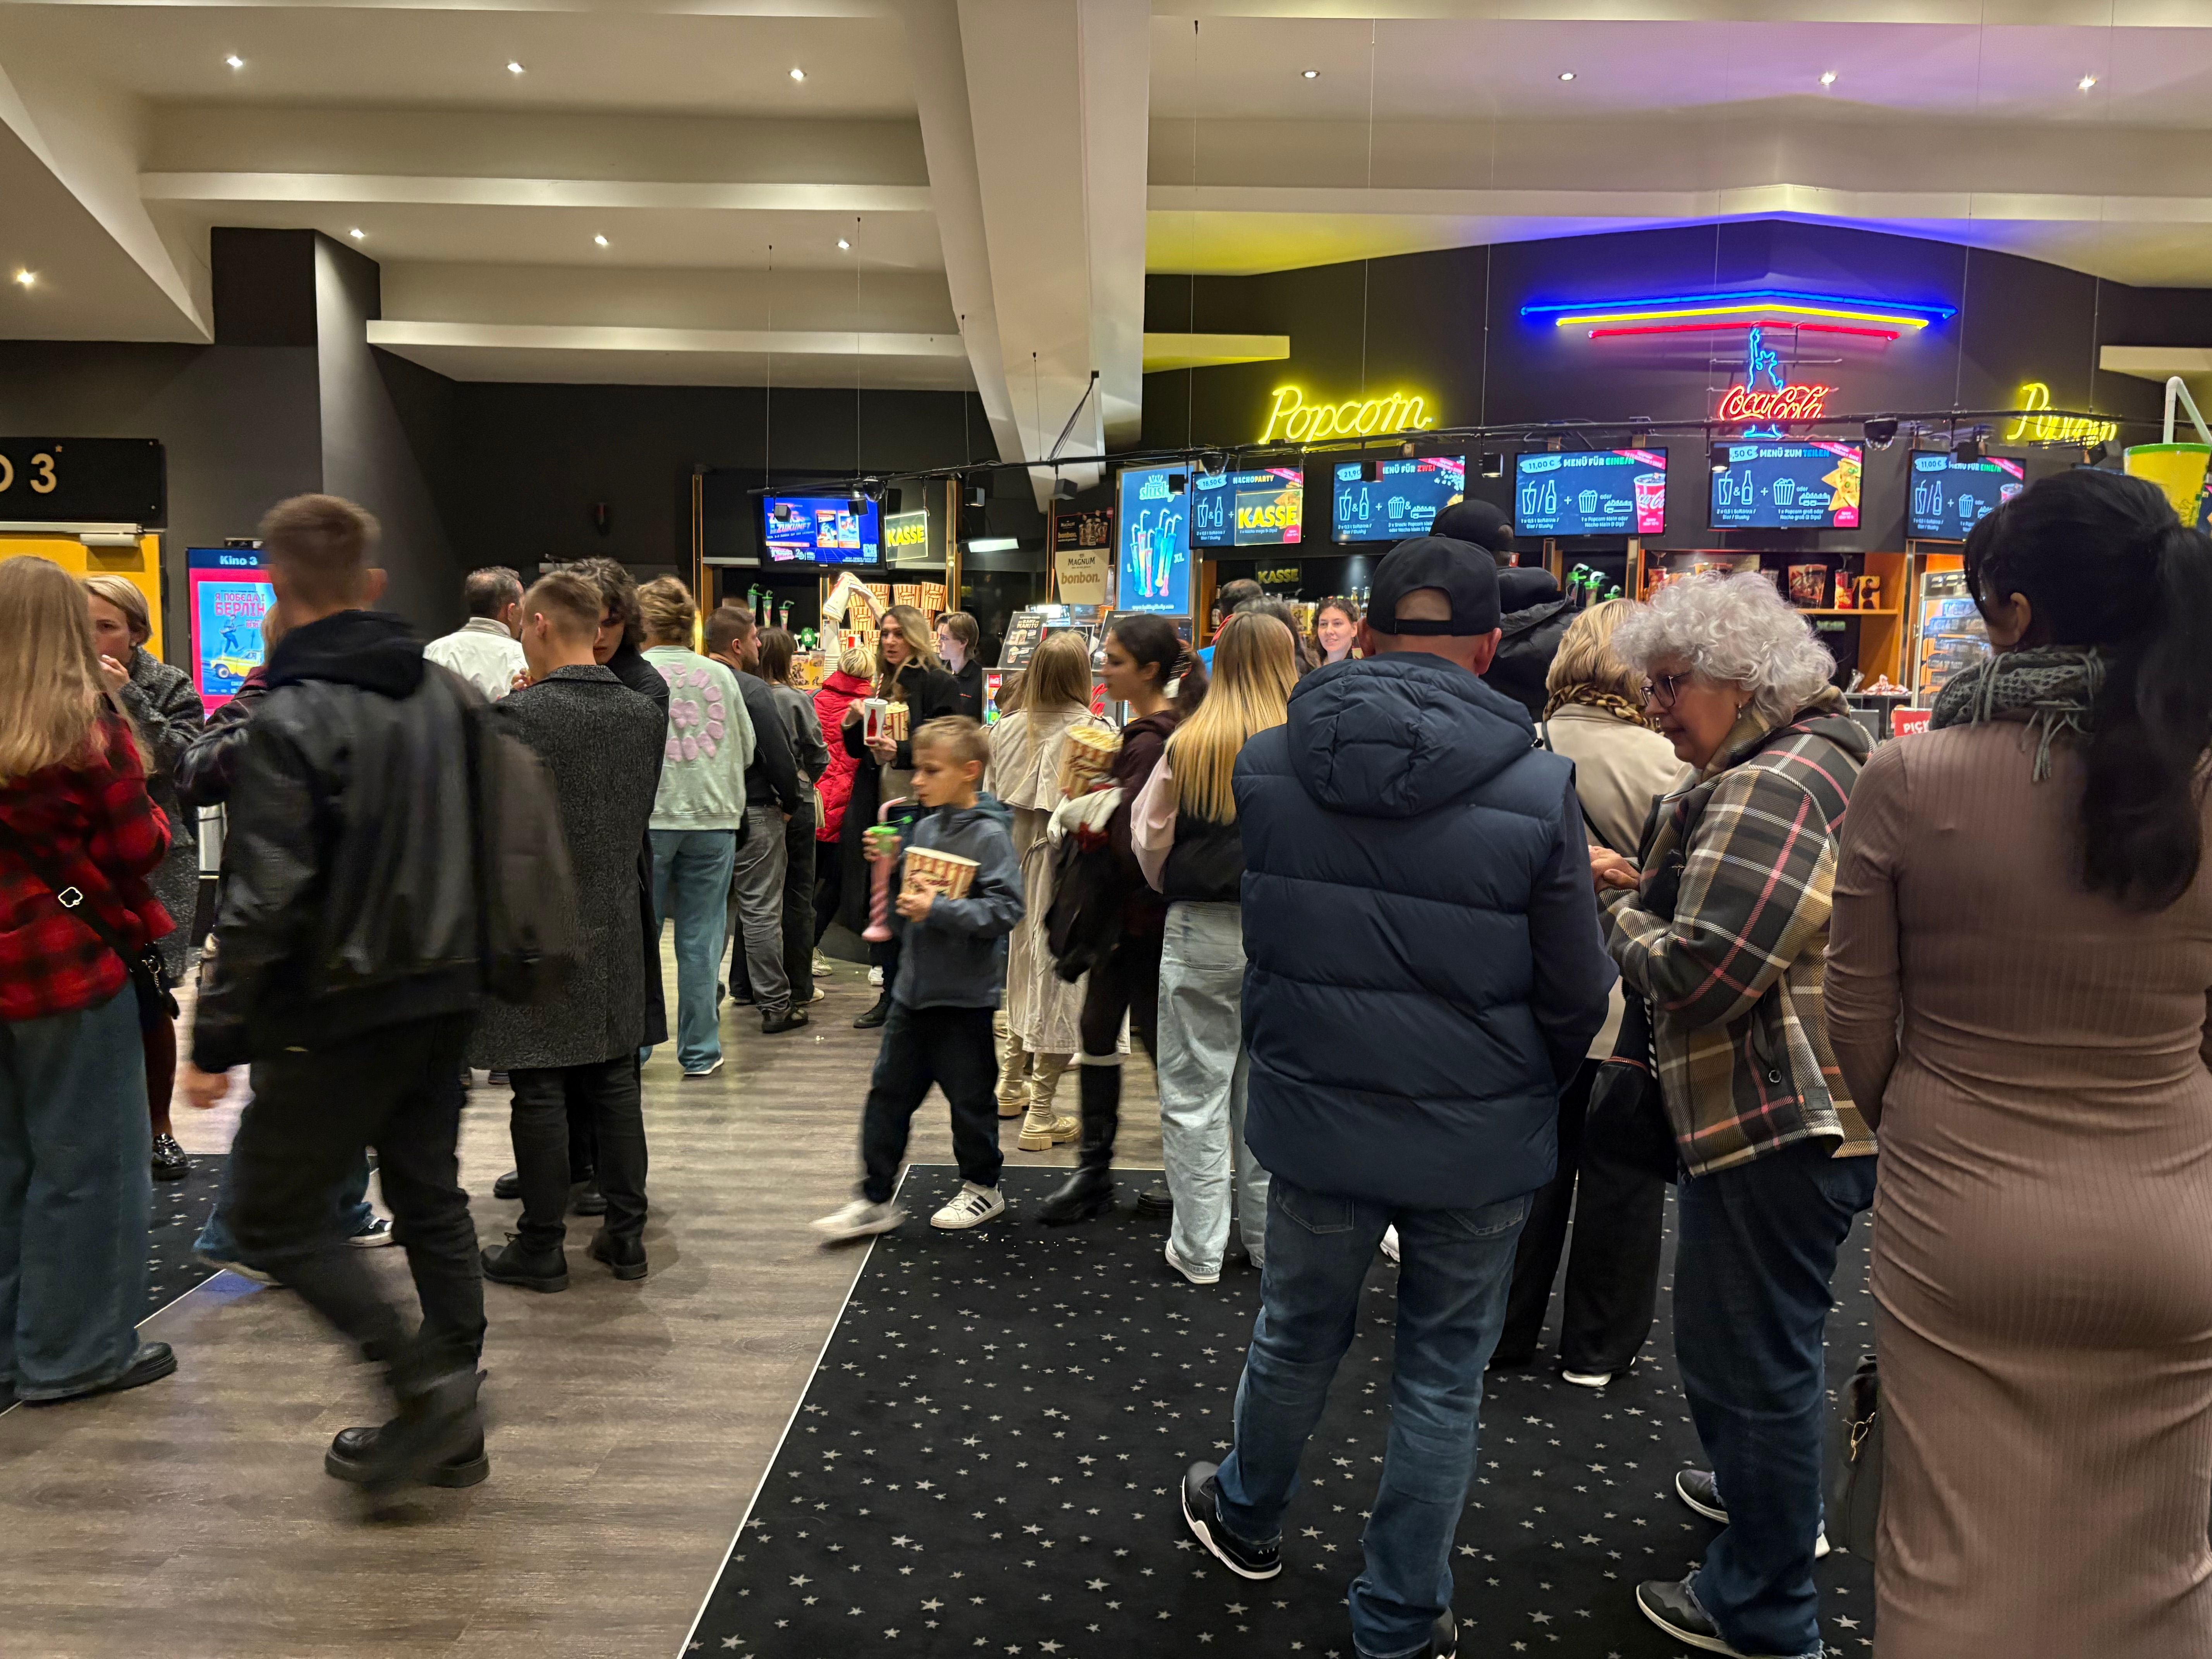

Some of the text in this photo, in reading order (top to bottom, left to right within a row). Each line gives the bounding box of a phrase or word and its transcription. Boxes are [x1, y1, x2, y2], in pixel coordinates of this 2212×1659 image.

[1258, 386, 1432, 445] Popcorn
[1760, 447, 1783, 458] MENÜ
[1784, 448, 1802, 458] ZUM
[1803, 448, 1831, 458] TEILEN
[1529, 461, 1547, 469] 11,00
[1563, 456, 1588, 467] MENÜ
[1588, 455, 1604, 466] FÜR
[30, 453, 57, 493] 3
[1383, 463, 1436, 474] ENÜ FÜR ZWEI
[1203, 479, 1217, 487] 18,50
[1233, 475, 1275, 484] NACHOPARTY
[1238, 505, 1298, 529] KASSE
[887, 524, 926, 548] KASSE
[220, 555, 258, 565] Kino 3
[1068, 556, 1096, 566] MAGNUM
[1173, 553, 1185, 563] XL
[1127, 563, 1133, 573] L
[1061, 572, 1100, 585] bonbon.
[1257, 568, 1299, 584] KASSE
[215, 593, 221, 601] Я
[215, 602, 265, 617] БЕРЛІН
